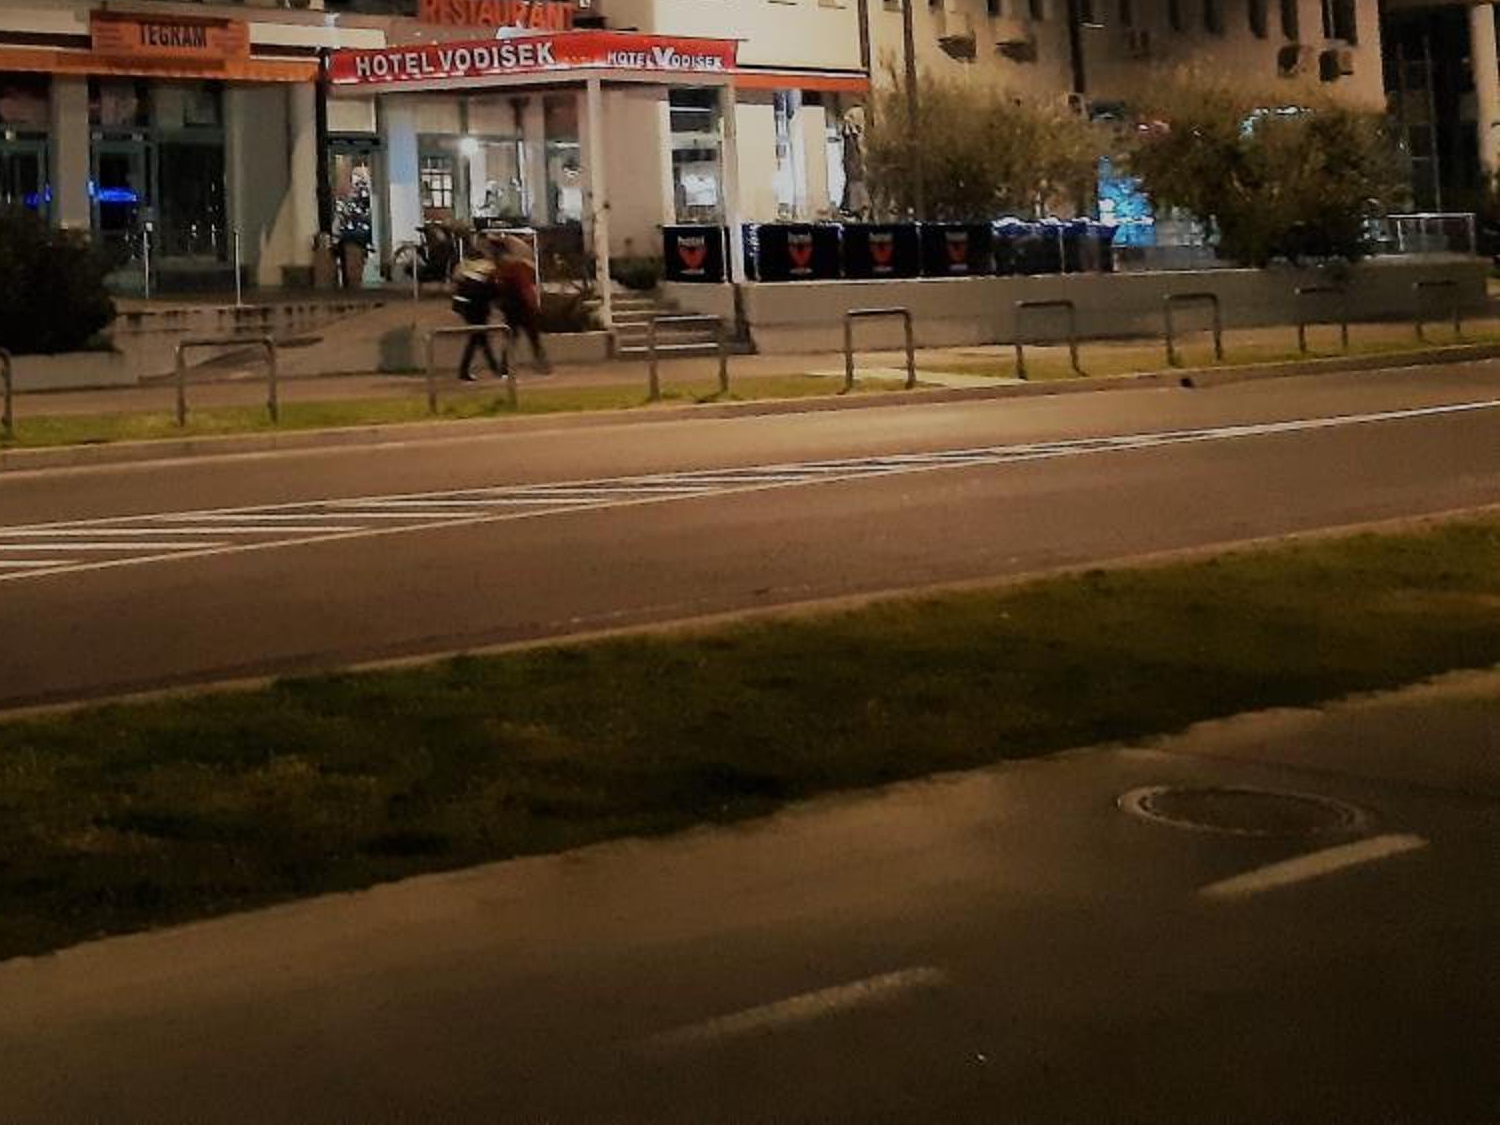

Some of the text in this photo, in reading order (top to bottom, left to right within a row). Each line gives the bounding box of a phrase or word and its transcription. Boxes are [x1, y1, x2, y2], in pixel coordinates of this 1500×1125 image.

[355, 38, 556, 77] HOTEL VODIŠEK
[607, 50, 653, 67] HOTEL
